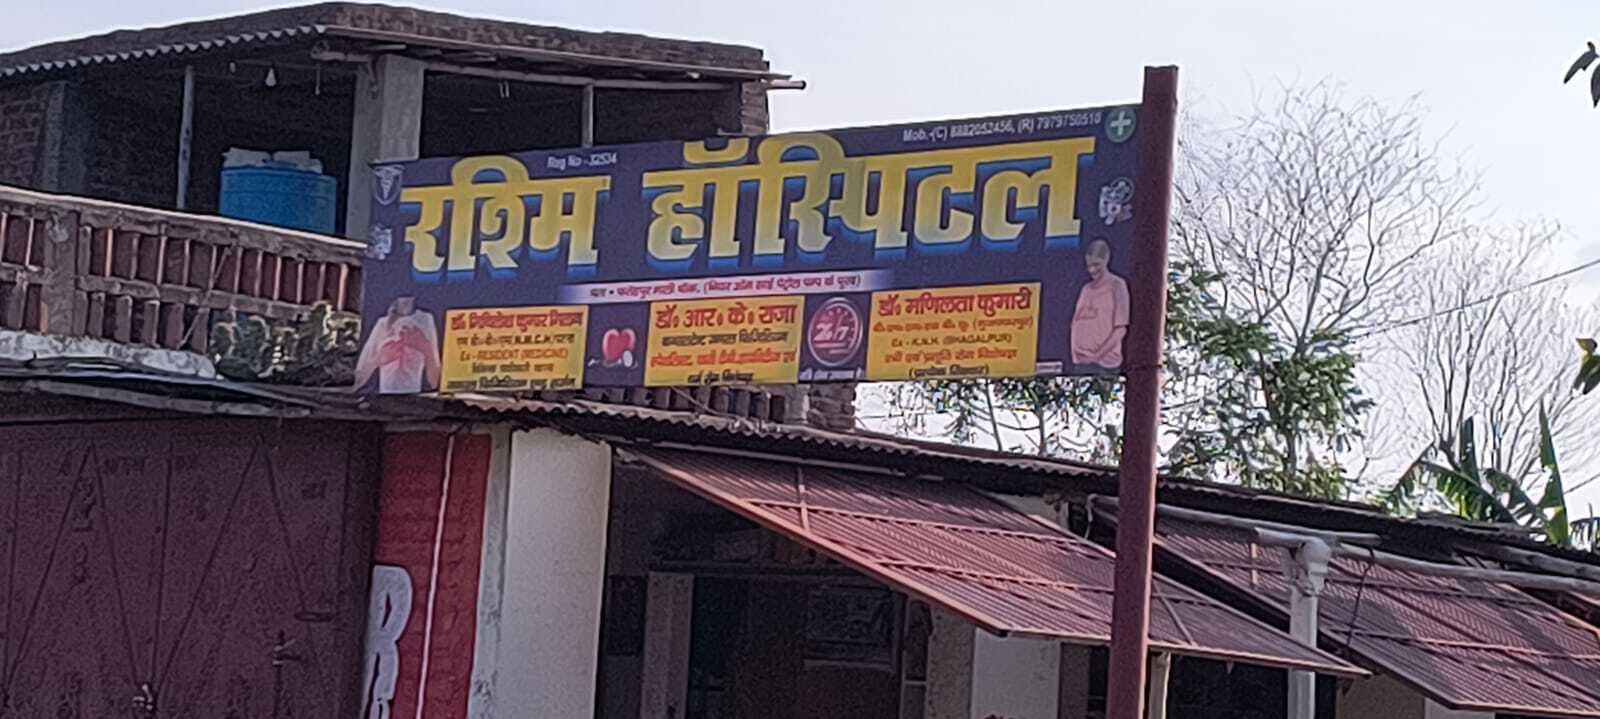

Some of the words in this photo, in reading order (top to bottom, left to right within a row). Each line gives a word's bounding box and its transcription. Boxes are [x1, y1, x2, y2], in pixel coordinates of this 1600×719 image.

[400, 155, 611, 274] रश्मि
[642, 132, 1096, 263] हॉस्पिटल
[758, 303, 798, 324] राजा
[904, 292, 975, 316] मणिलता
[977, 286, 1033, 318] कुमारी
